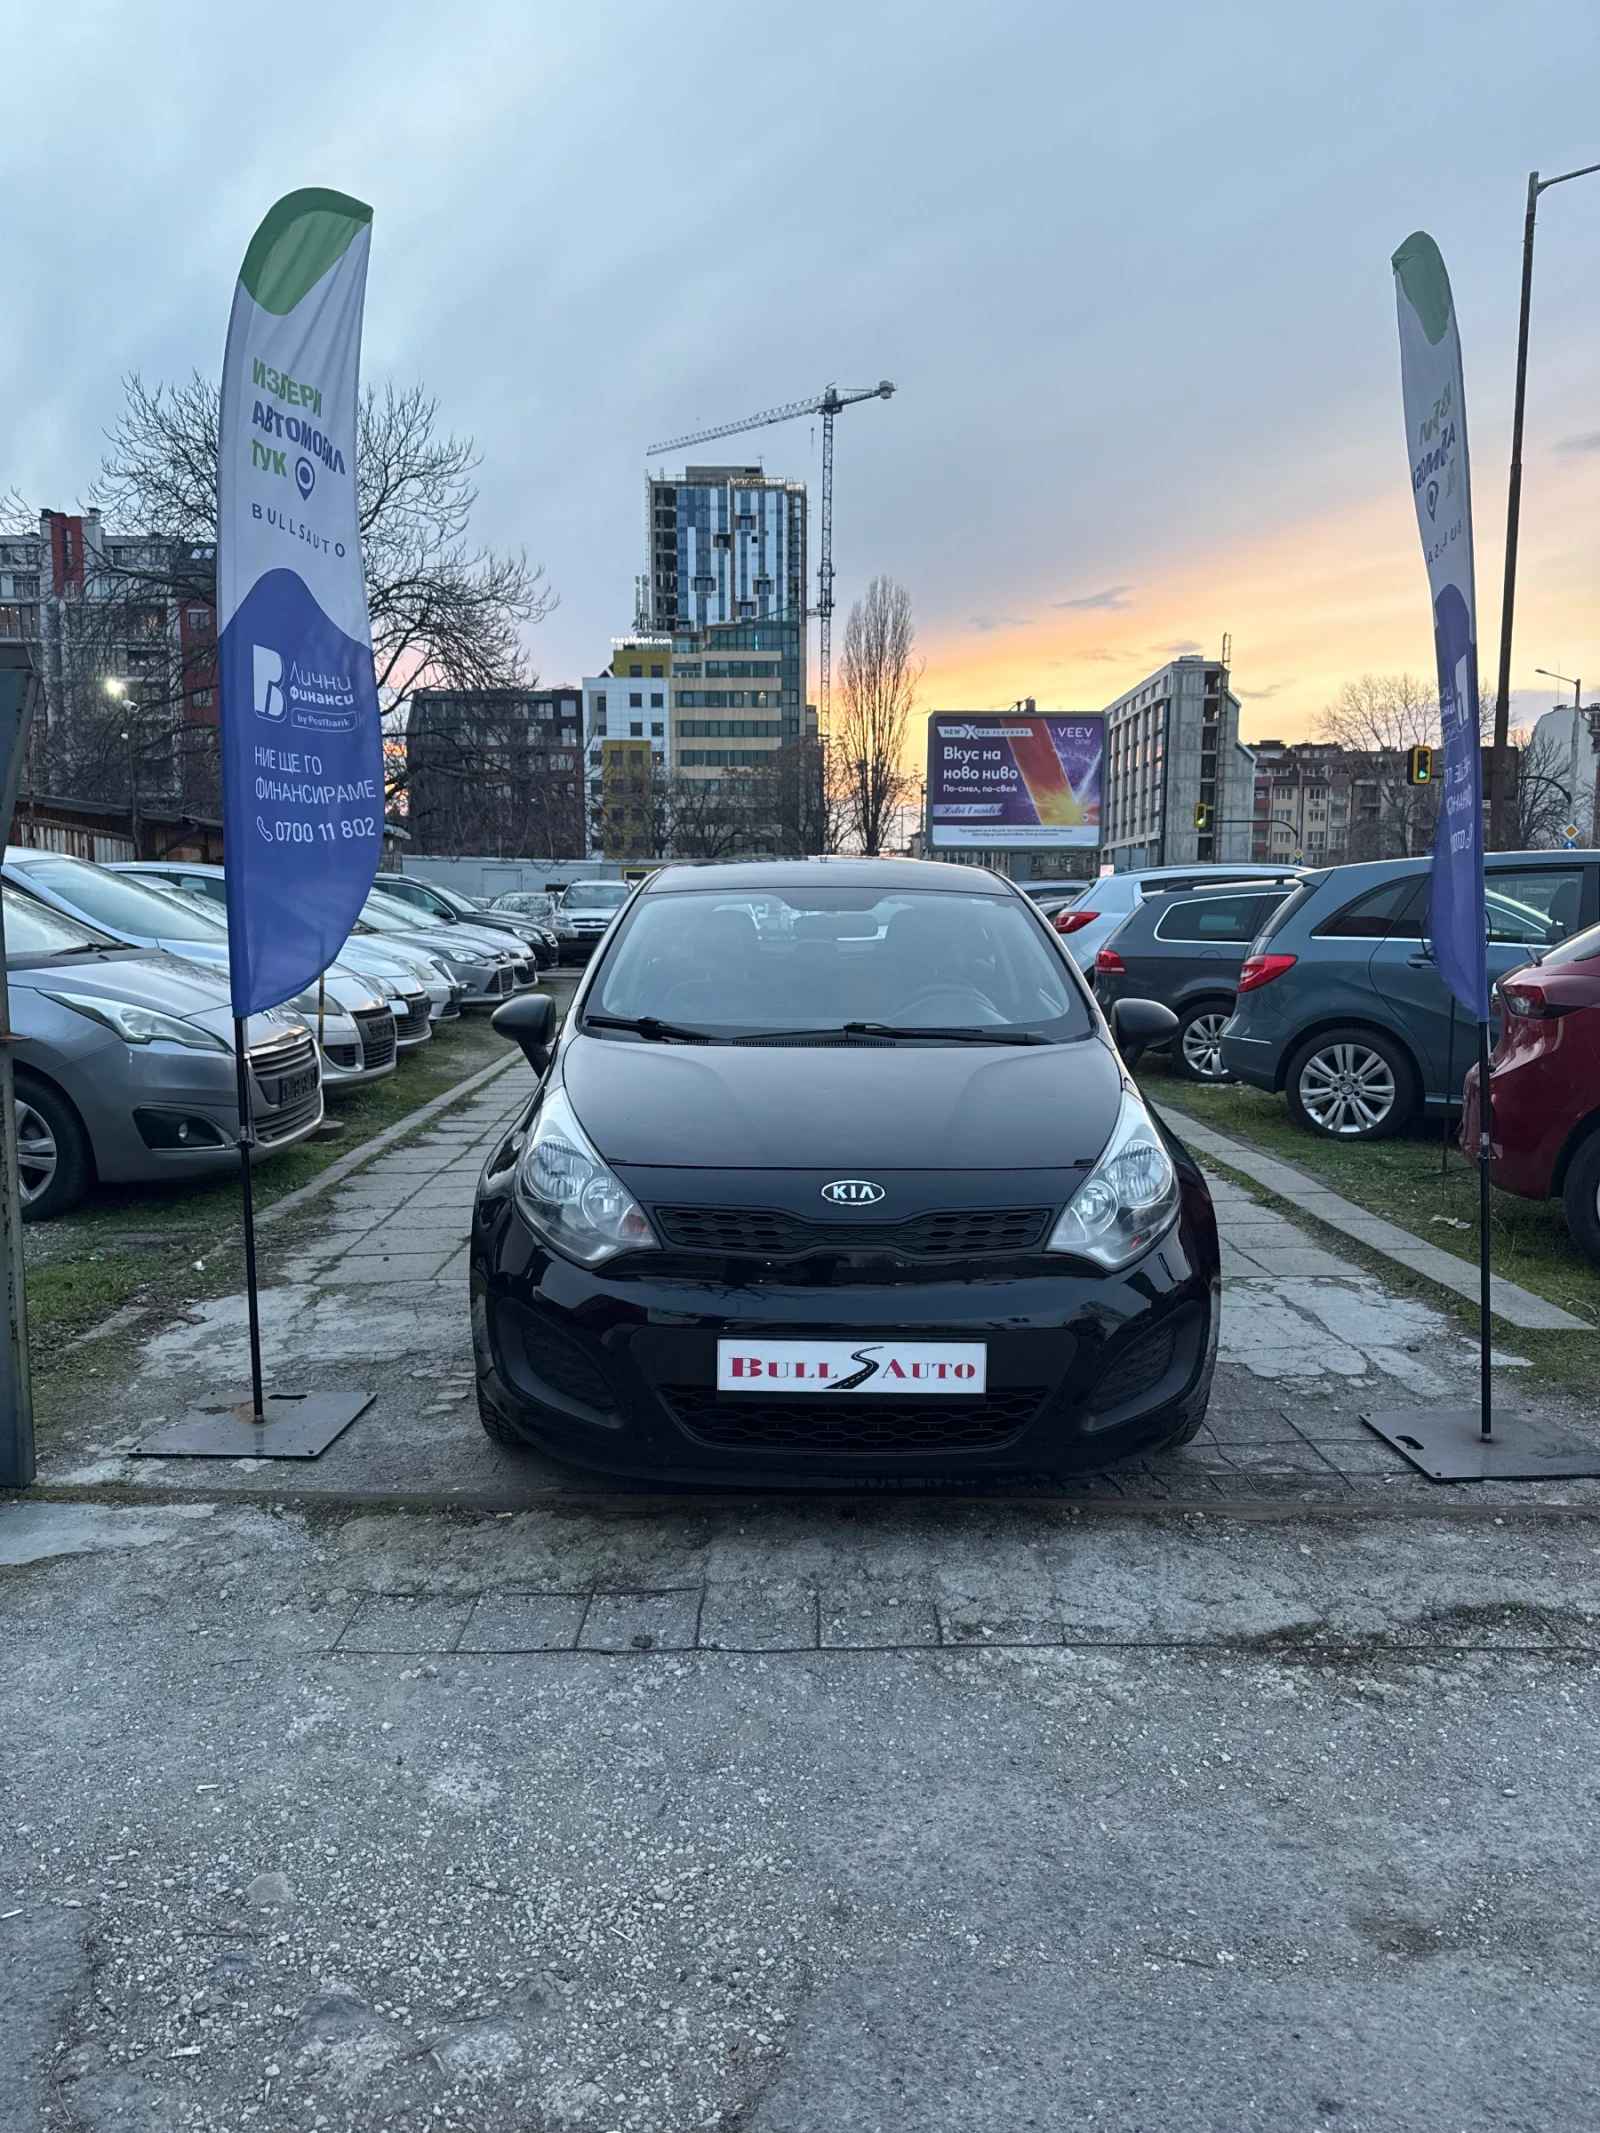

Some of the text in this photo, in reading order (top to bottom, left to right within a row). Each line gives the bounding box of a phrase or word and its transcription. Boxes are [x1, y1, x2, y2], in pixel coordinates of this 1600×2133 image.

[253, 357, 322, 418] ИЗБЕРИ
[252, 400, 345, 475] АВТОМОБИЛ
[252, 438, 287, 478] ТУК
[252, 503, 345, 557] BULLSAUTO
[610, 636, 672, 645] easyHotel.com
[290, 661, 352, 691] Лични
[290, 685, 354, 706] Финанси
[297, 714, 350, 727] by Postbank
[1057, 727, 1093, 737] VEEV
[255, 745, 322, 775] НИЕ ЩЕ ГО
[943, 746, 1001, 764] Вкус на
[943, 766, 1018, 779] ново ниво
[255, 776, 376, 804] ФИНАНСИРАМЕ
[943, 784, 1018, 794] По-смел, по-свеж
[275, 817, 376, 842] 0700 11 802
[833, 1185, 876, 1200] KIA
